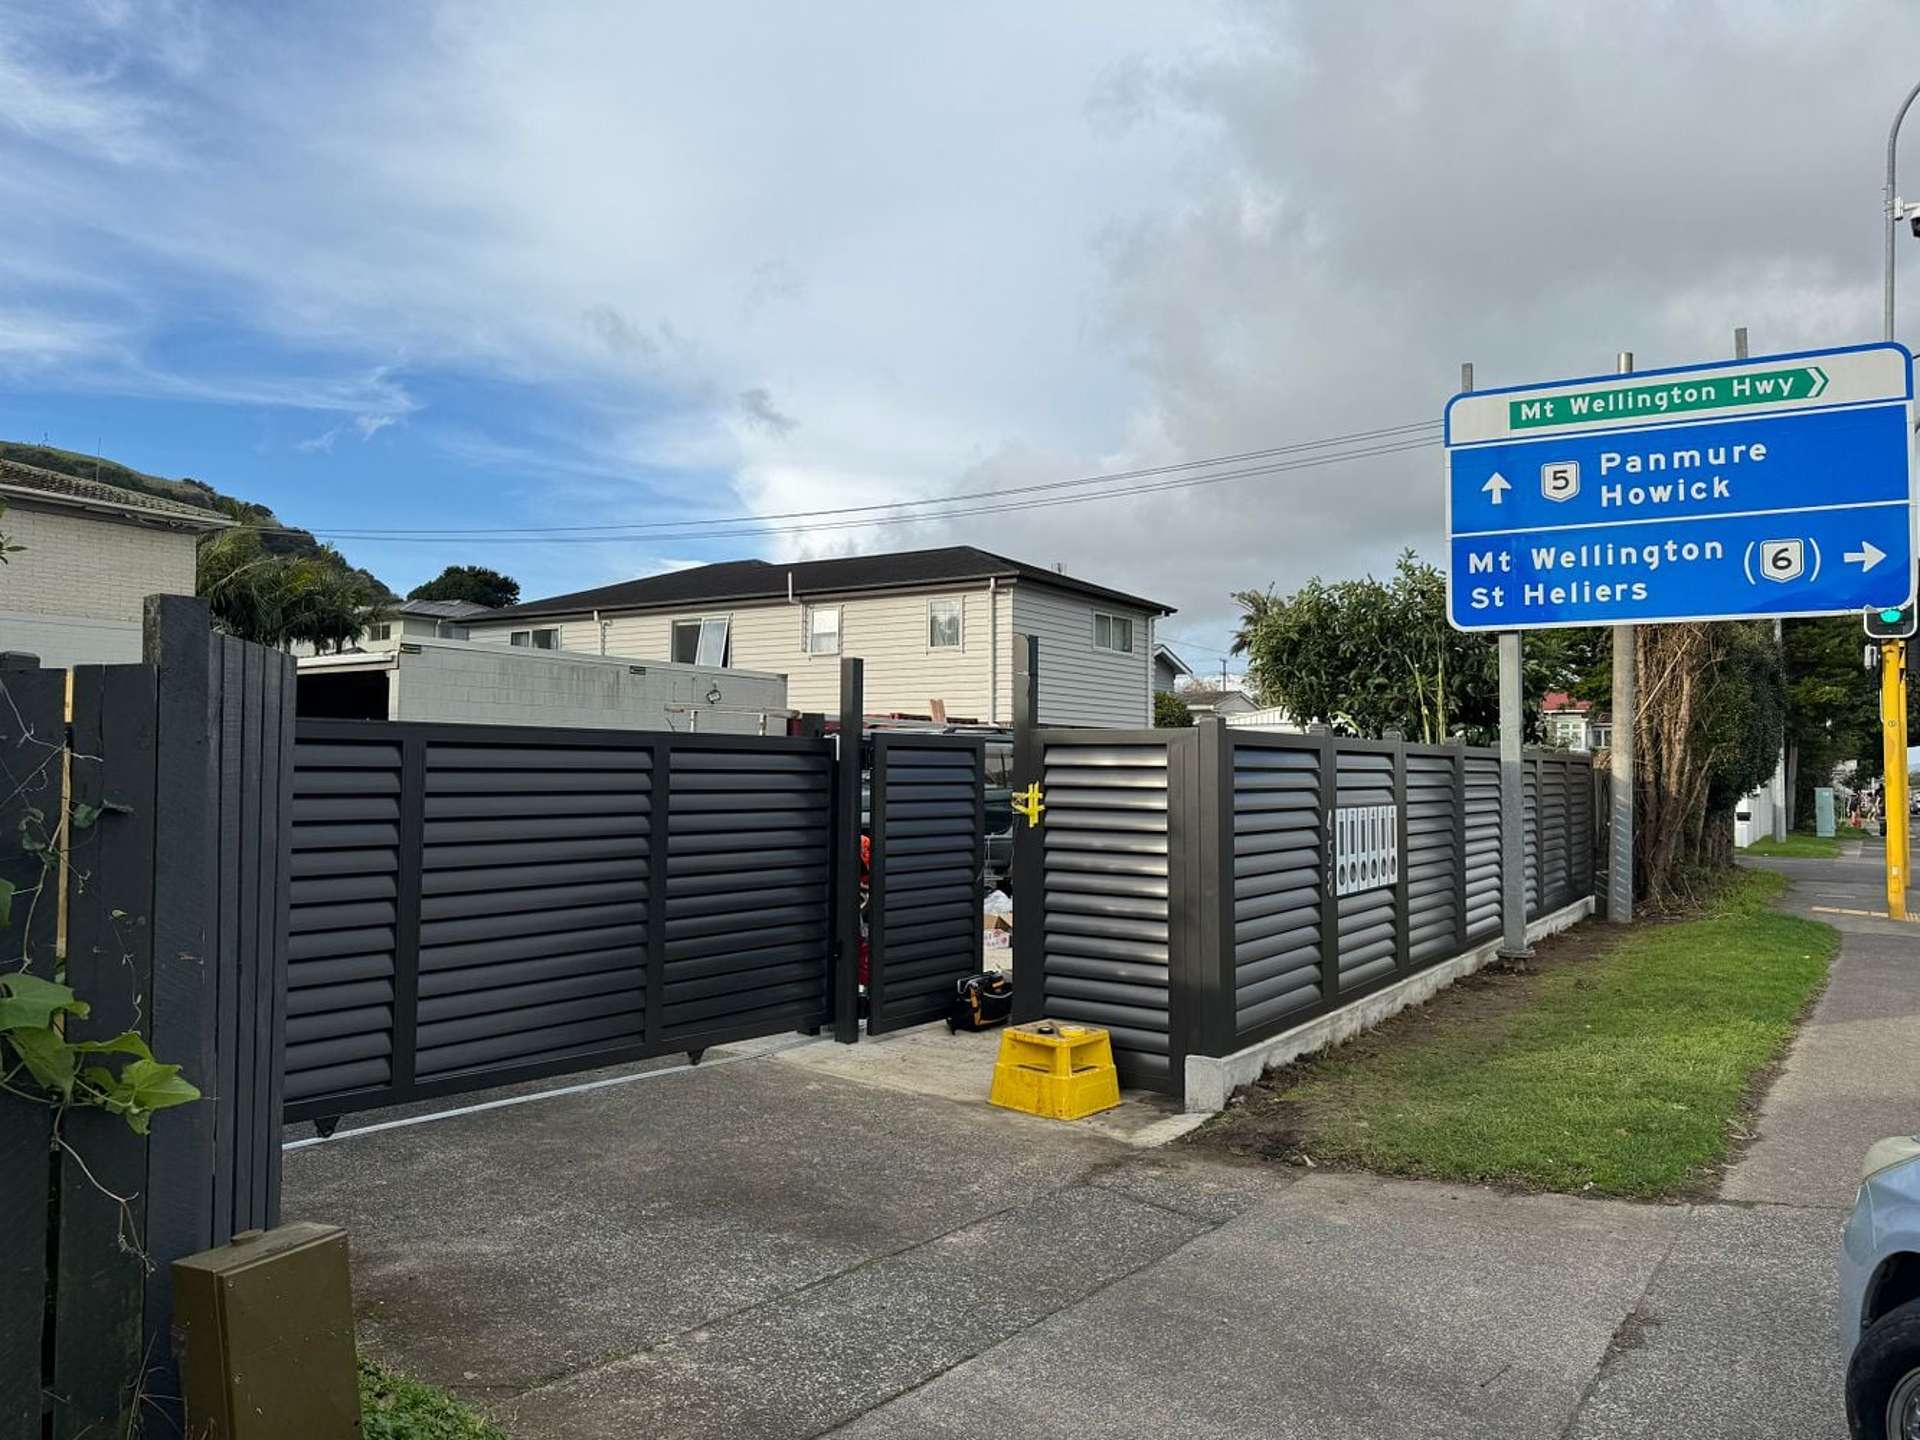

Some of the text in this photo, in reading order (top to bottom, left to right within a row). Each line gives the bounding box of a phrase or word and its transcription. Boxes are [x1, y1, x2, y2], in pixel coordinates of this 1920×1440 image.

[1521, 375, 1794, 420] Mt Wellington Hwy
[1600, 442, 1768, 475] Panmure
[1553, 470, 1570, 491] 5
[1600, 476, 1730, 507] Howick
[1469, 540, 1723, 574] Mt Wellington
[1471, 581, 1648, 609] St Heliers
